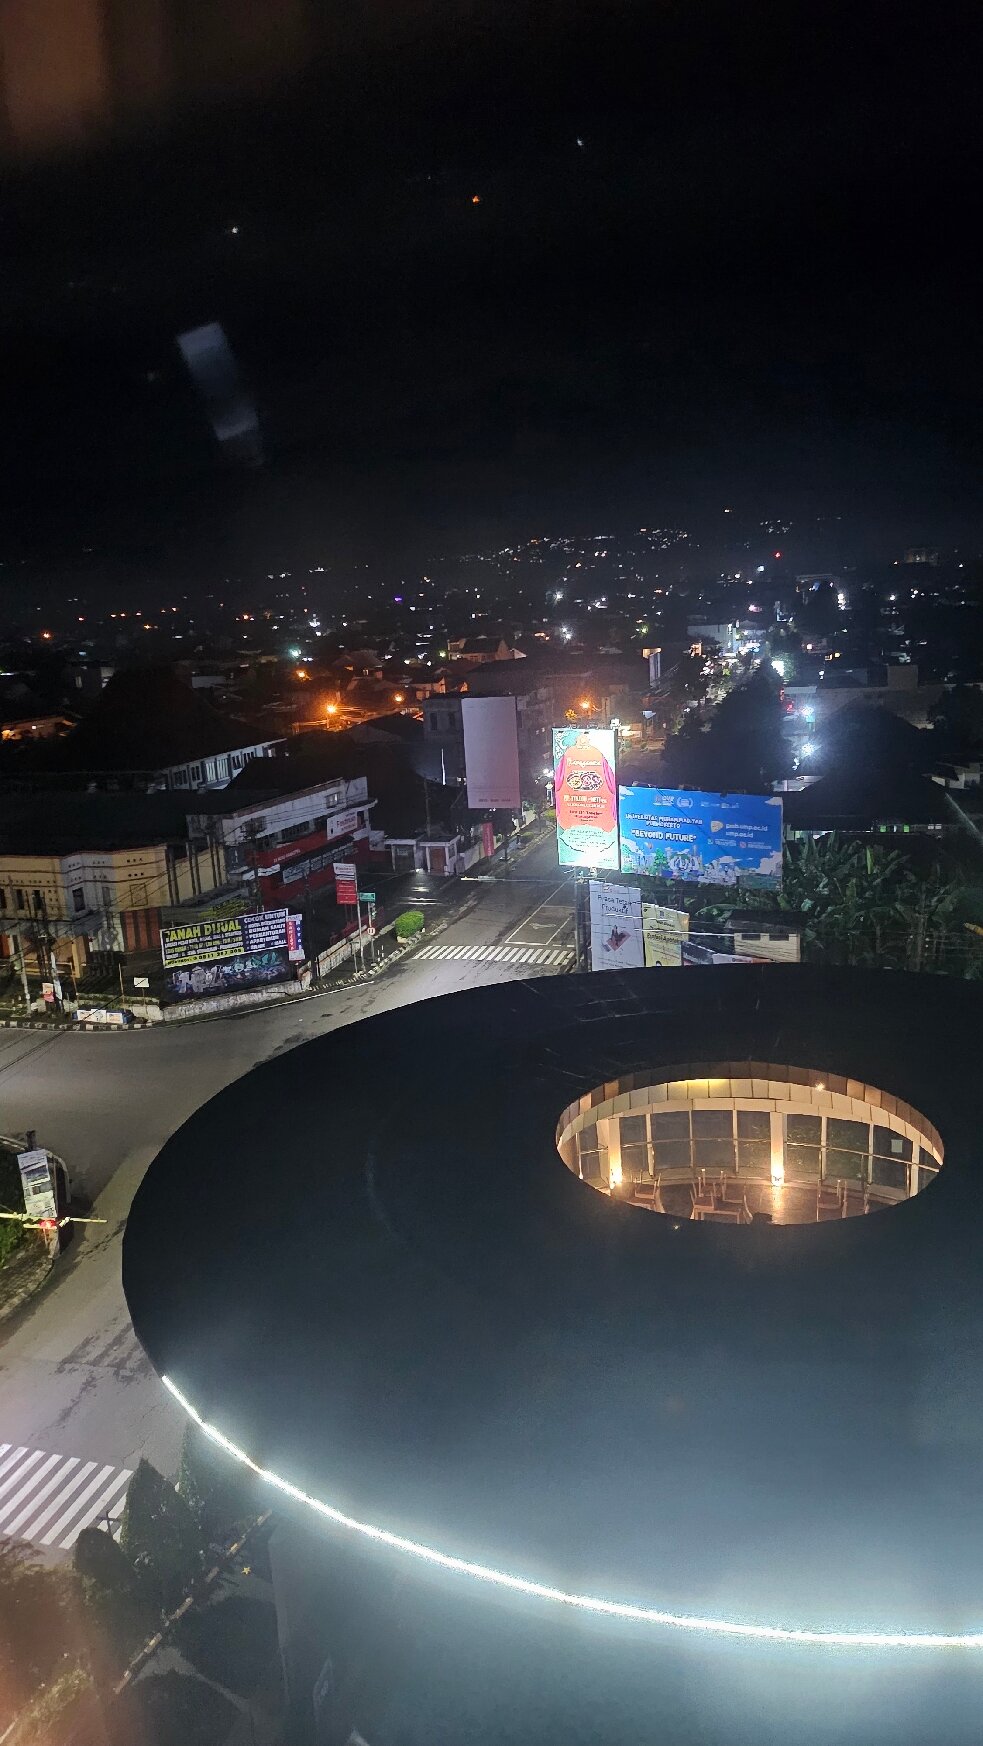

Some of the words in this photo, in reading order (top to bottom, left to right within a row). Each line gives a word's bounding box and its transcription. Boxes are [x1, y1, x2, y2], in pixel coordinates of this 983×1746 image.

[625, 813, 658, 821] UNIVERSITAS
[659, 816, 703, 825] MUHAMMADIYAH
[243, 914, 264, 923] COCOK
[264, 911, 286, 920] UNTUK
[164, 925, 201, 943] TANAH
[204, 919, 242, 936] DIJUAL
[249, 925, 270, 934] RUMAH
